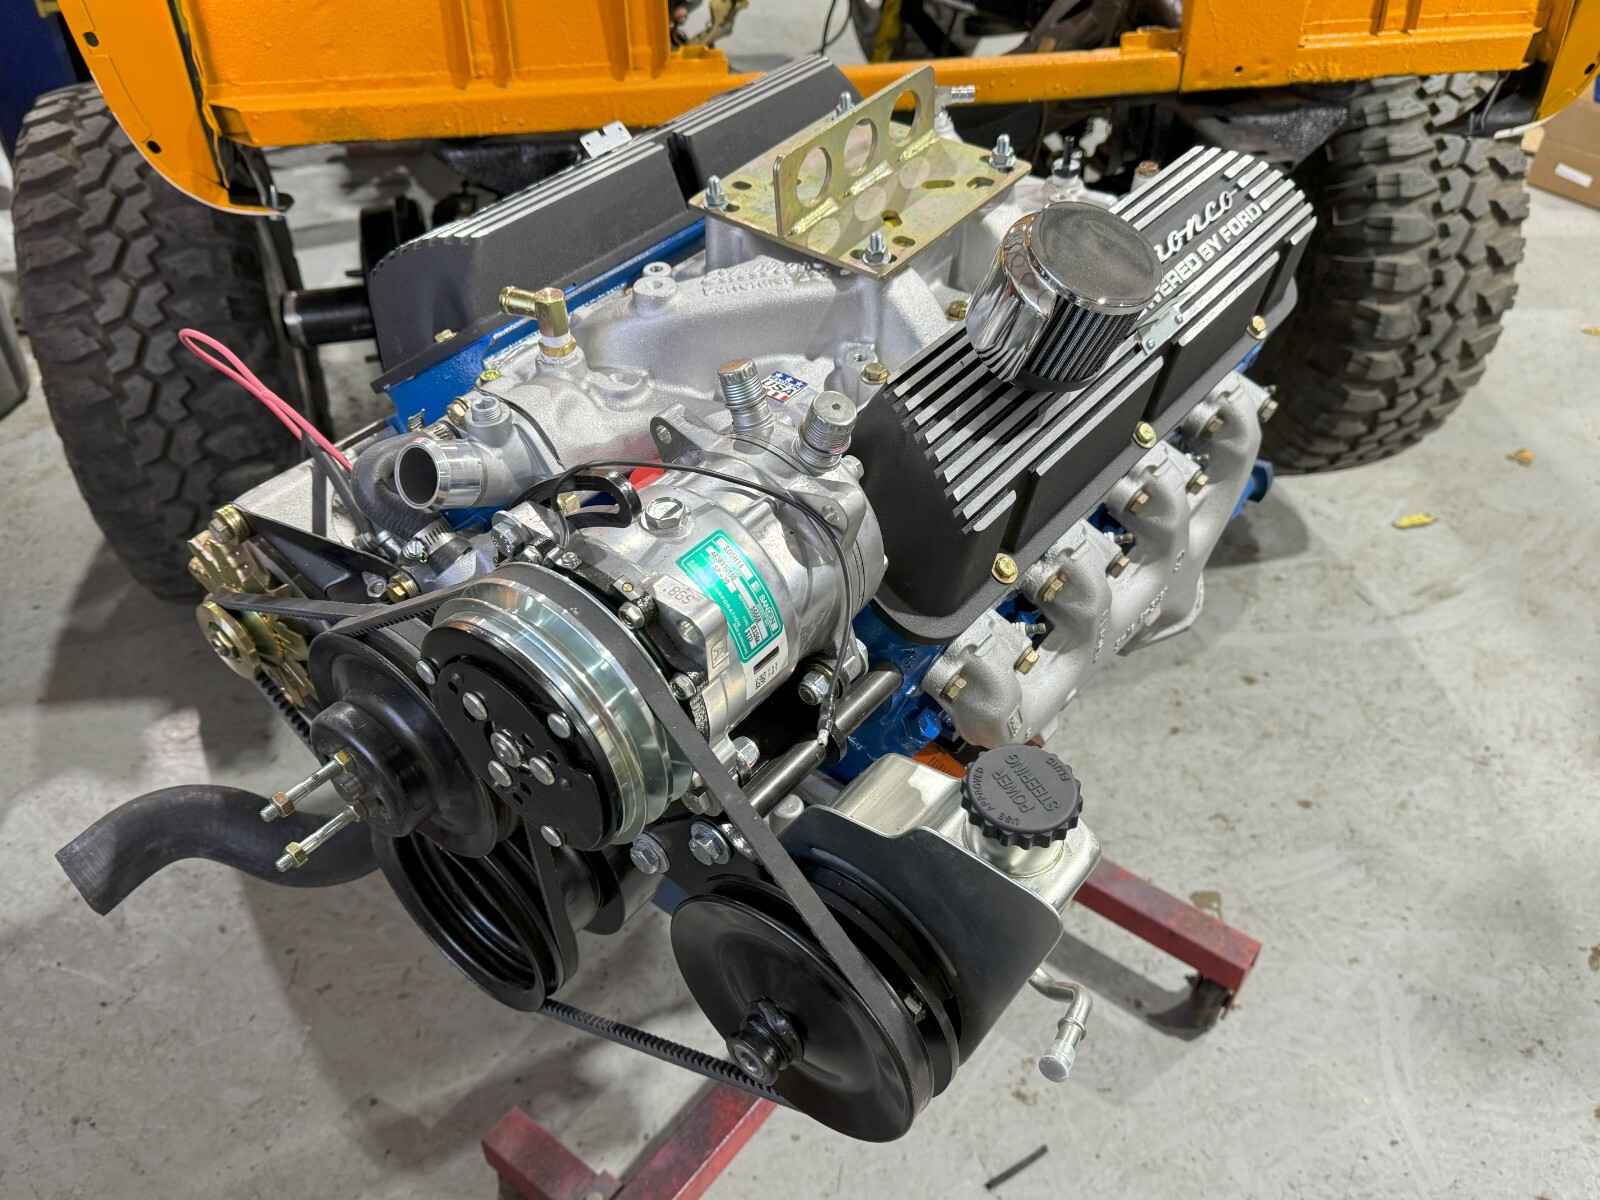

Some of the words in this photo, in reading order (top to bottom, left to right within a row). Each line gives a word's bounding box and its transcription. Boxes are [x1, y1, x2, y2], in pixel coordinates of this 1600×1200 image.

[1154, 189, 1237, 264] ronco
[1197, 232, 1223, 263] BY
[1218, 201, 1264, 244] FORD
[762, 379, 795, 396] USA
[759, 594, 777, 625] SANDEN
[992, 769, 1035, 813] POWER
[1005, 754, 1059, 811] STEERING
[1046, 757, 1070, 781] FLUID
